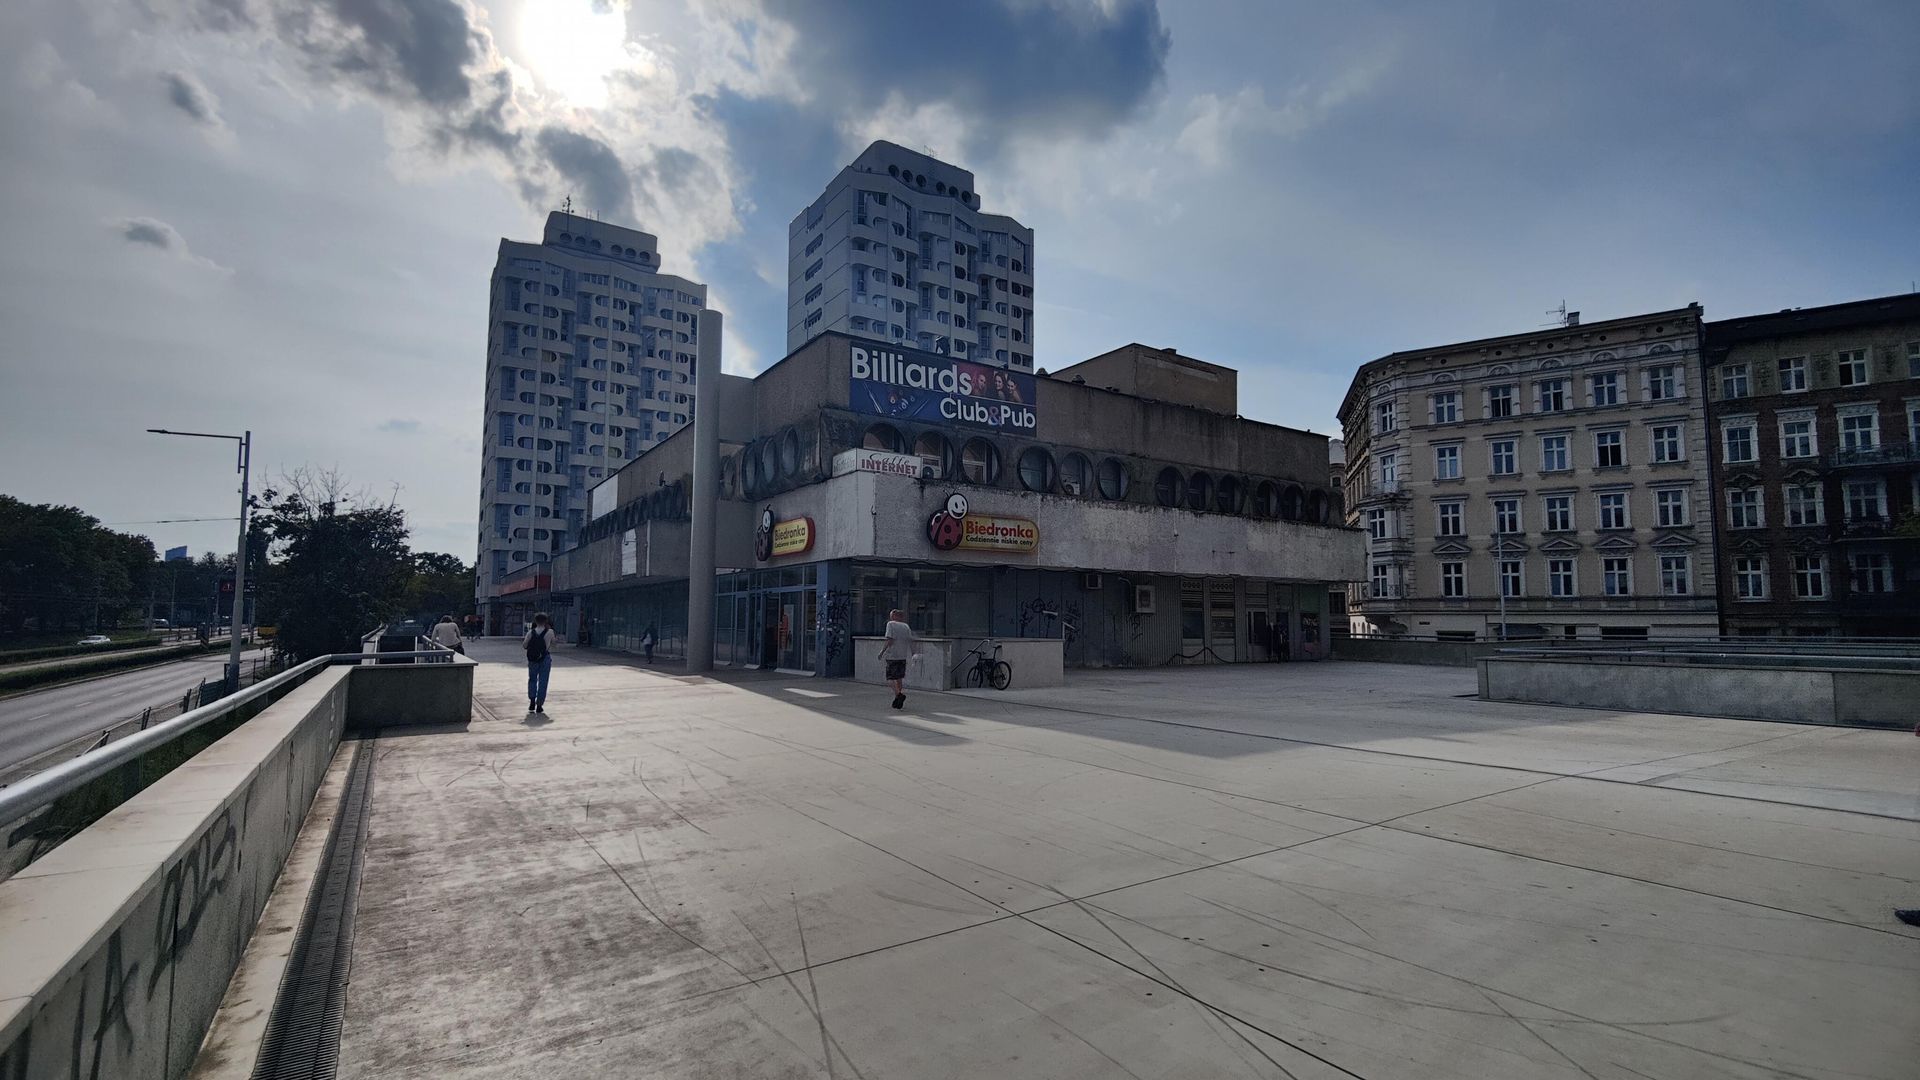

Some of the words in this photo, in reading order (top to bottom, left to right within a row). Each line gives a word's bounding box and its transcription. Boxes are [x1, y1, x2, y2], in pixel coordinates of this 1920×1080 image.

[851, 346, 973, 396] Billiards
[939, 397, 1036, 429] Club&Pub
[861, 458, 918, 475] INTERNET
[775, 525, 806, 541] Biedronka
[966, 520, 1034, 538] Biedronka
[966, 535, 999, 544] Codziennie
